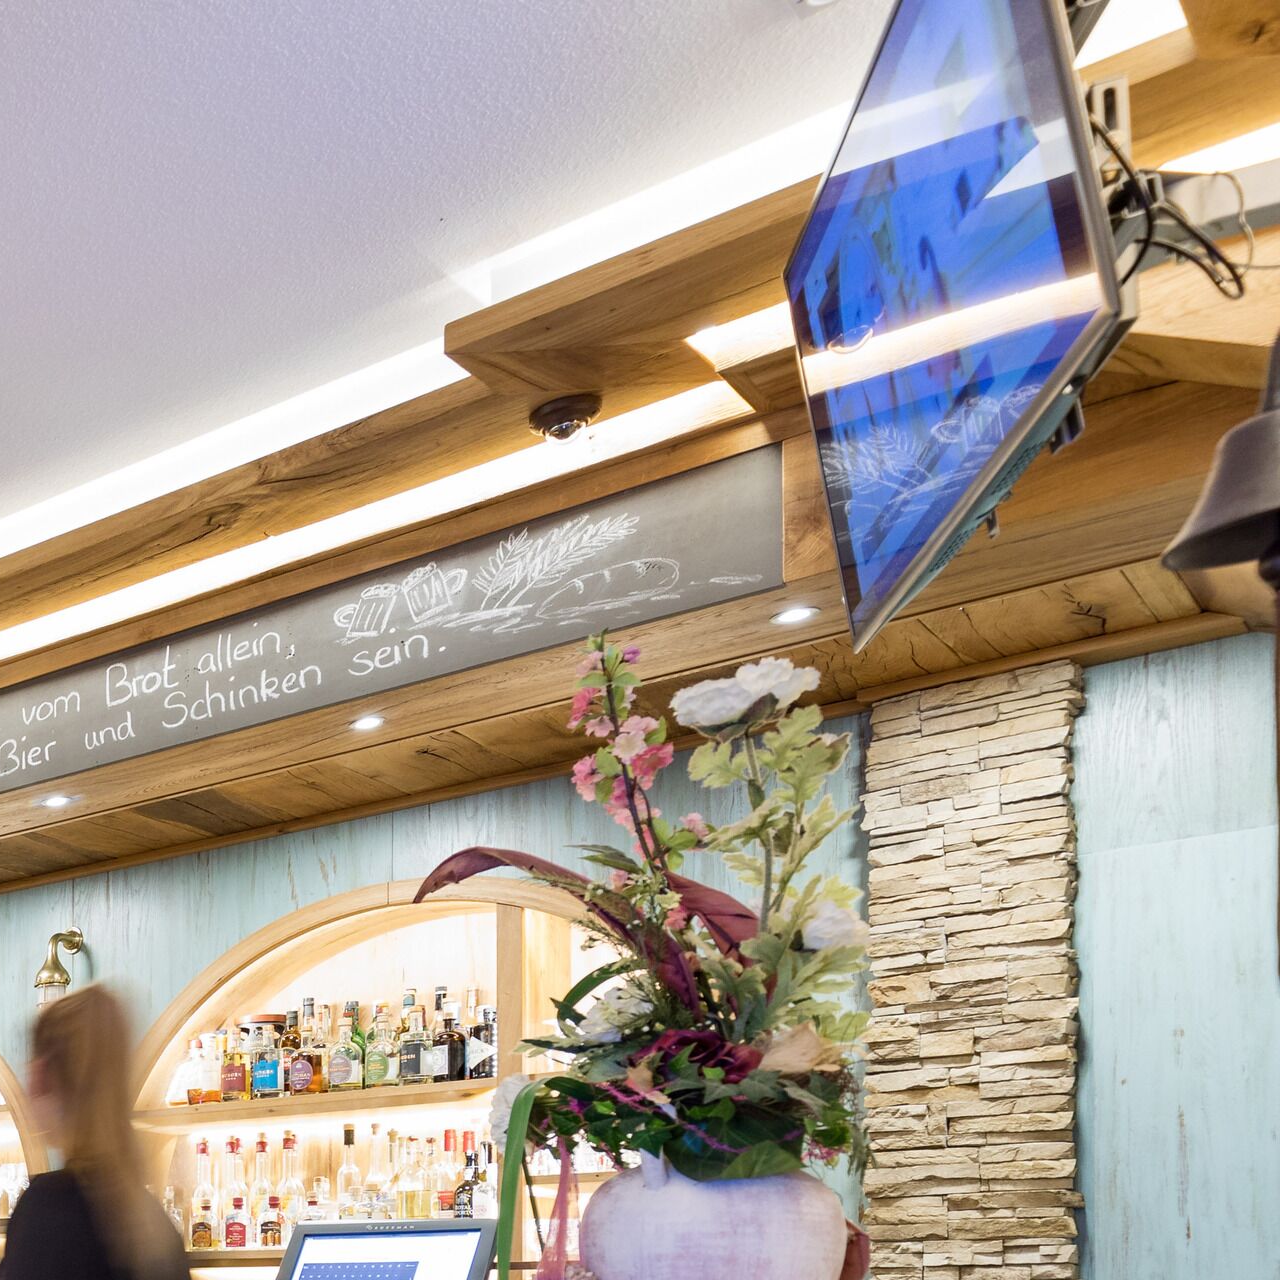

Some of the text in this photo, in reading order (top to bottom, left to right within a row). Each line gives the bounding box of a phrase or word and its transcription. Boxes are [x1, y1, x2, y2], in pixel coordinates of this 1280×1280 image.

[22, 691, 81, 726] vom
[105, 645, 179, 707] Brot
[198, 622, 295, 675] allein,
[85, 711, 136, 750] und
[161, 664, 322, 728] Schinken
[348, 627, 446, 676] sein.
